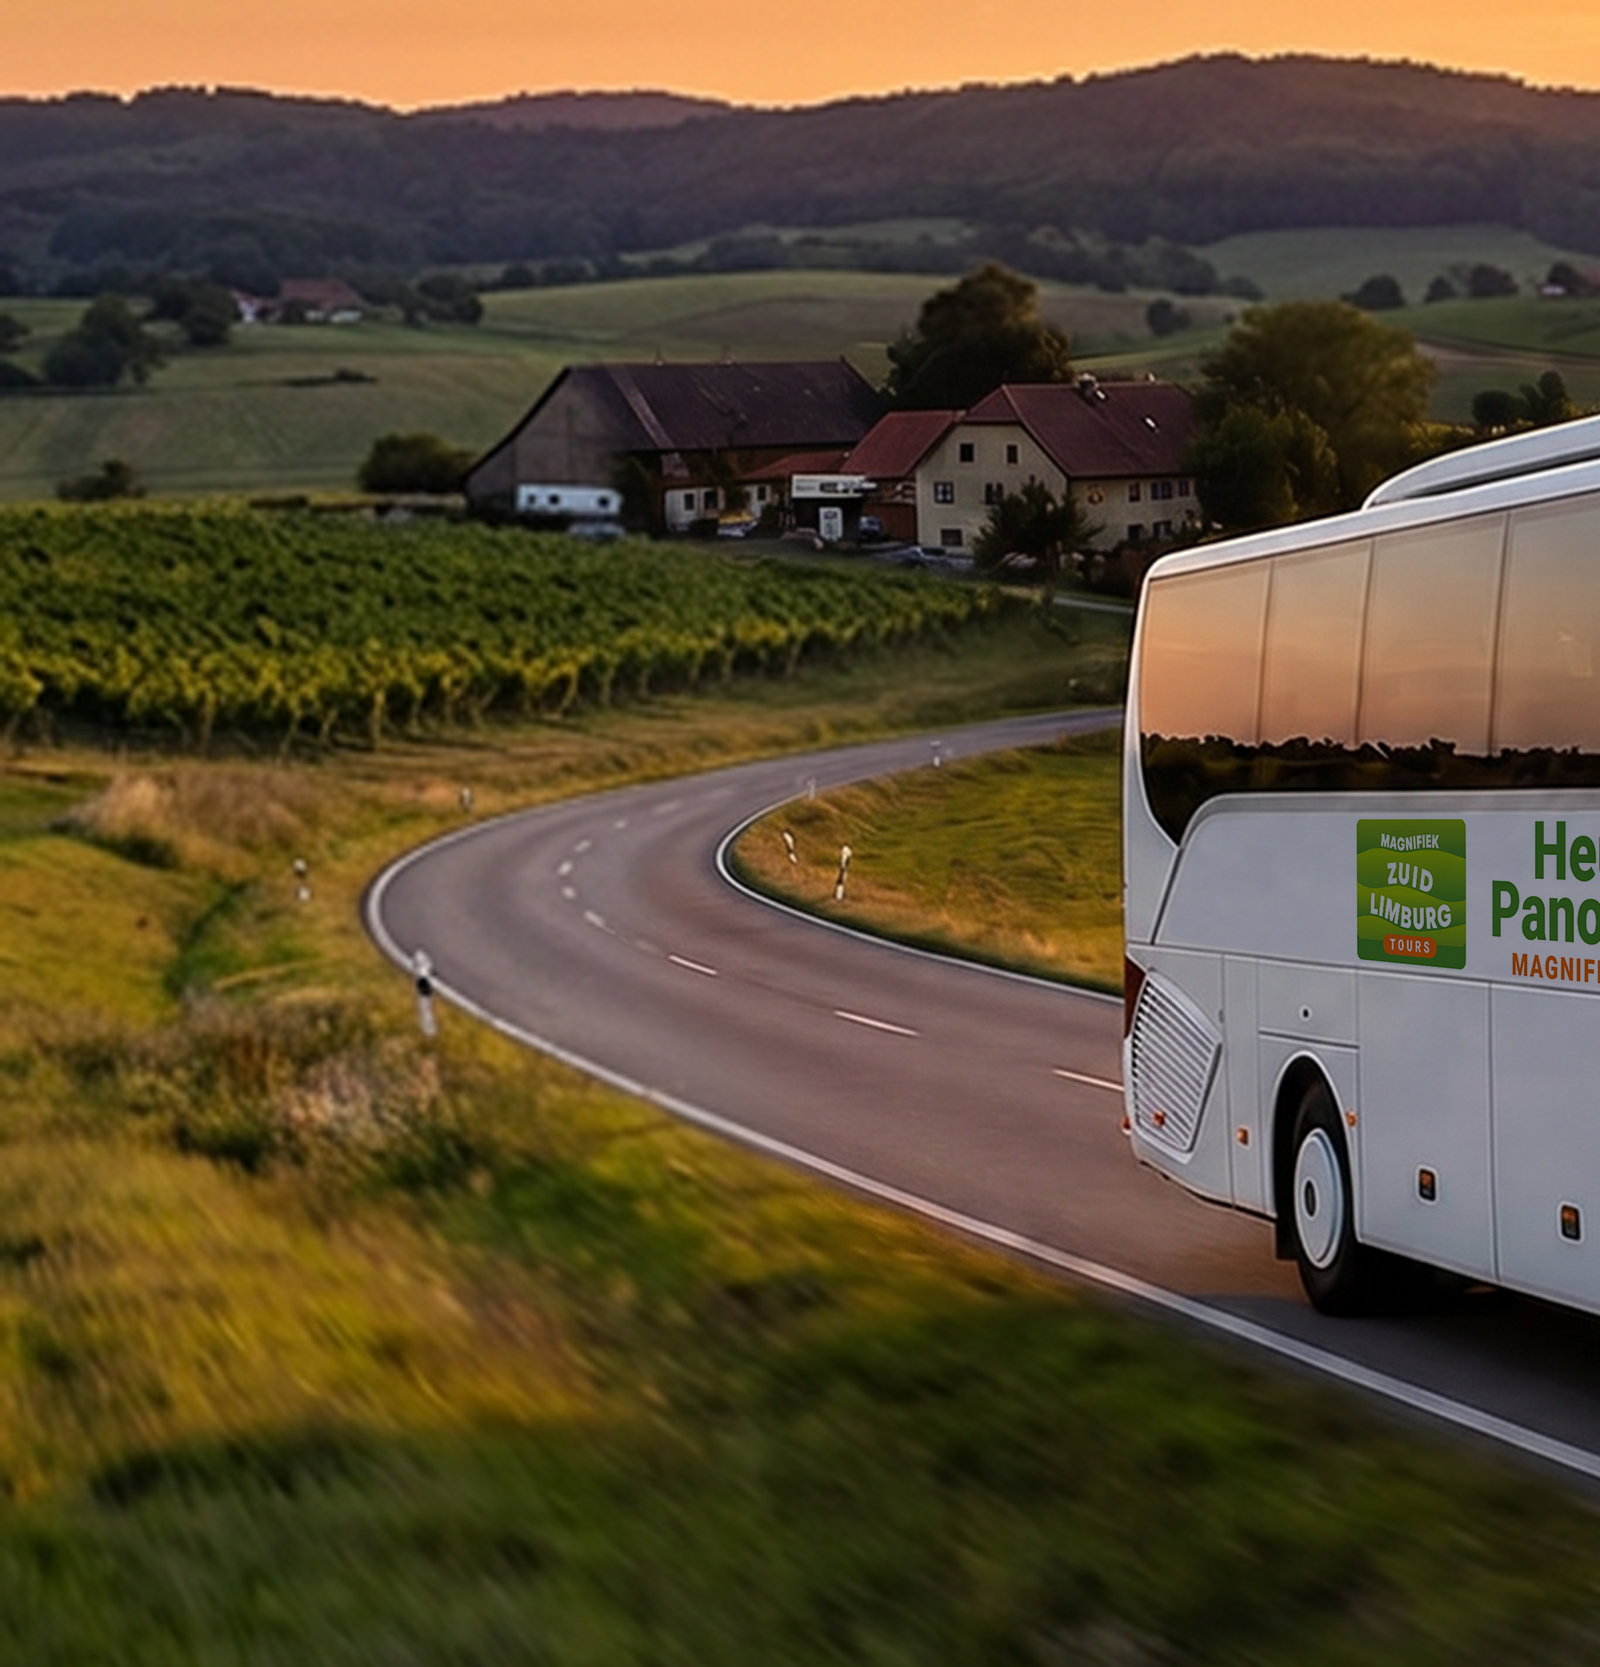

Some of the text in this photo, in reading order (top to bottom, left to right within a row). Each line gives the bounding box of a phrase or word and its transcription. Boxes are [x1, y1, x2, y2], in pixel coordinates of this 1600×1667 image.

[1381, 833, 1440, 851] MAGNIFIEK
[1387, 862, 1434, 892] ZUID
[1370, 892, 1452, 930] LIMBURG
[1390, 938, 1430, 954] TOURS
